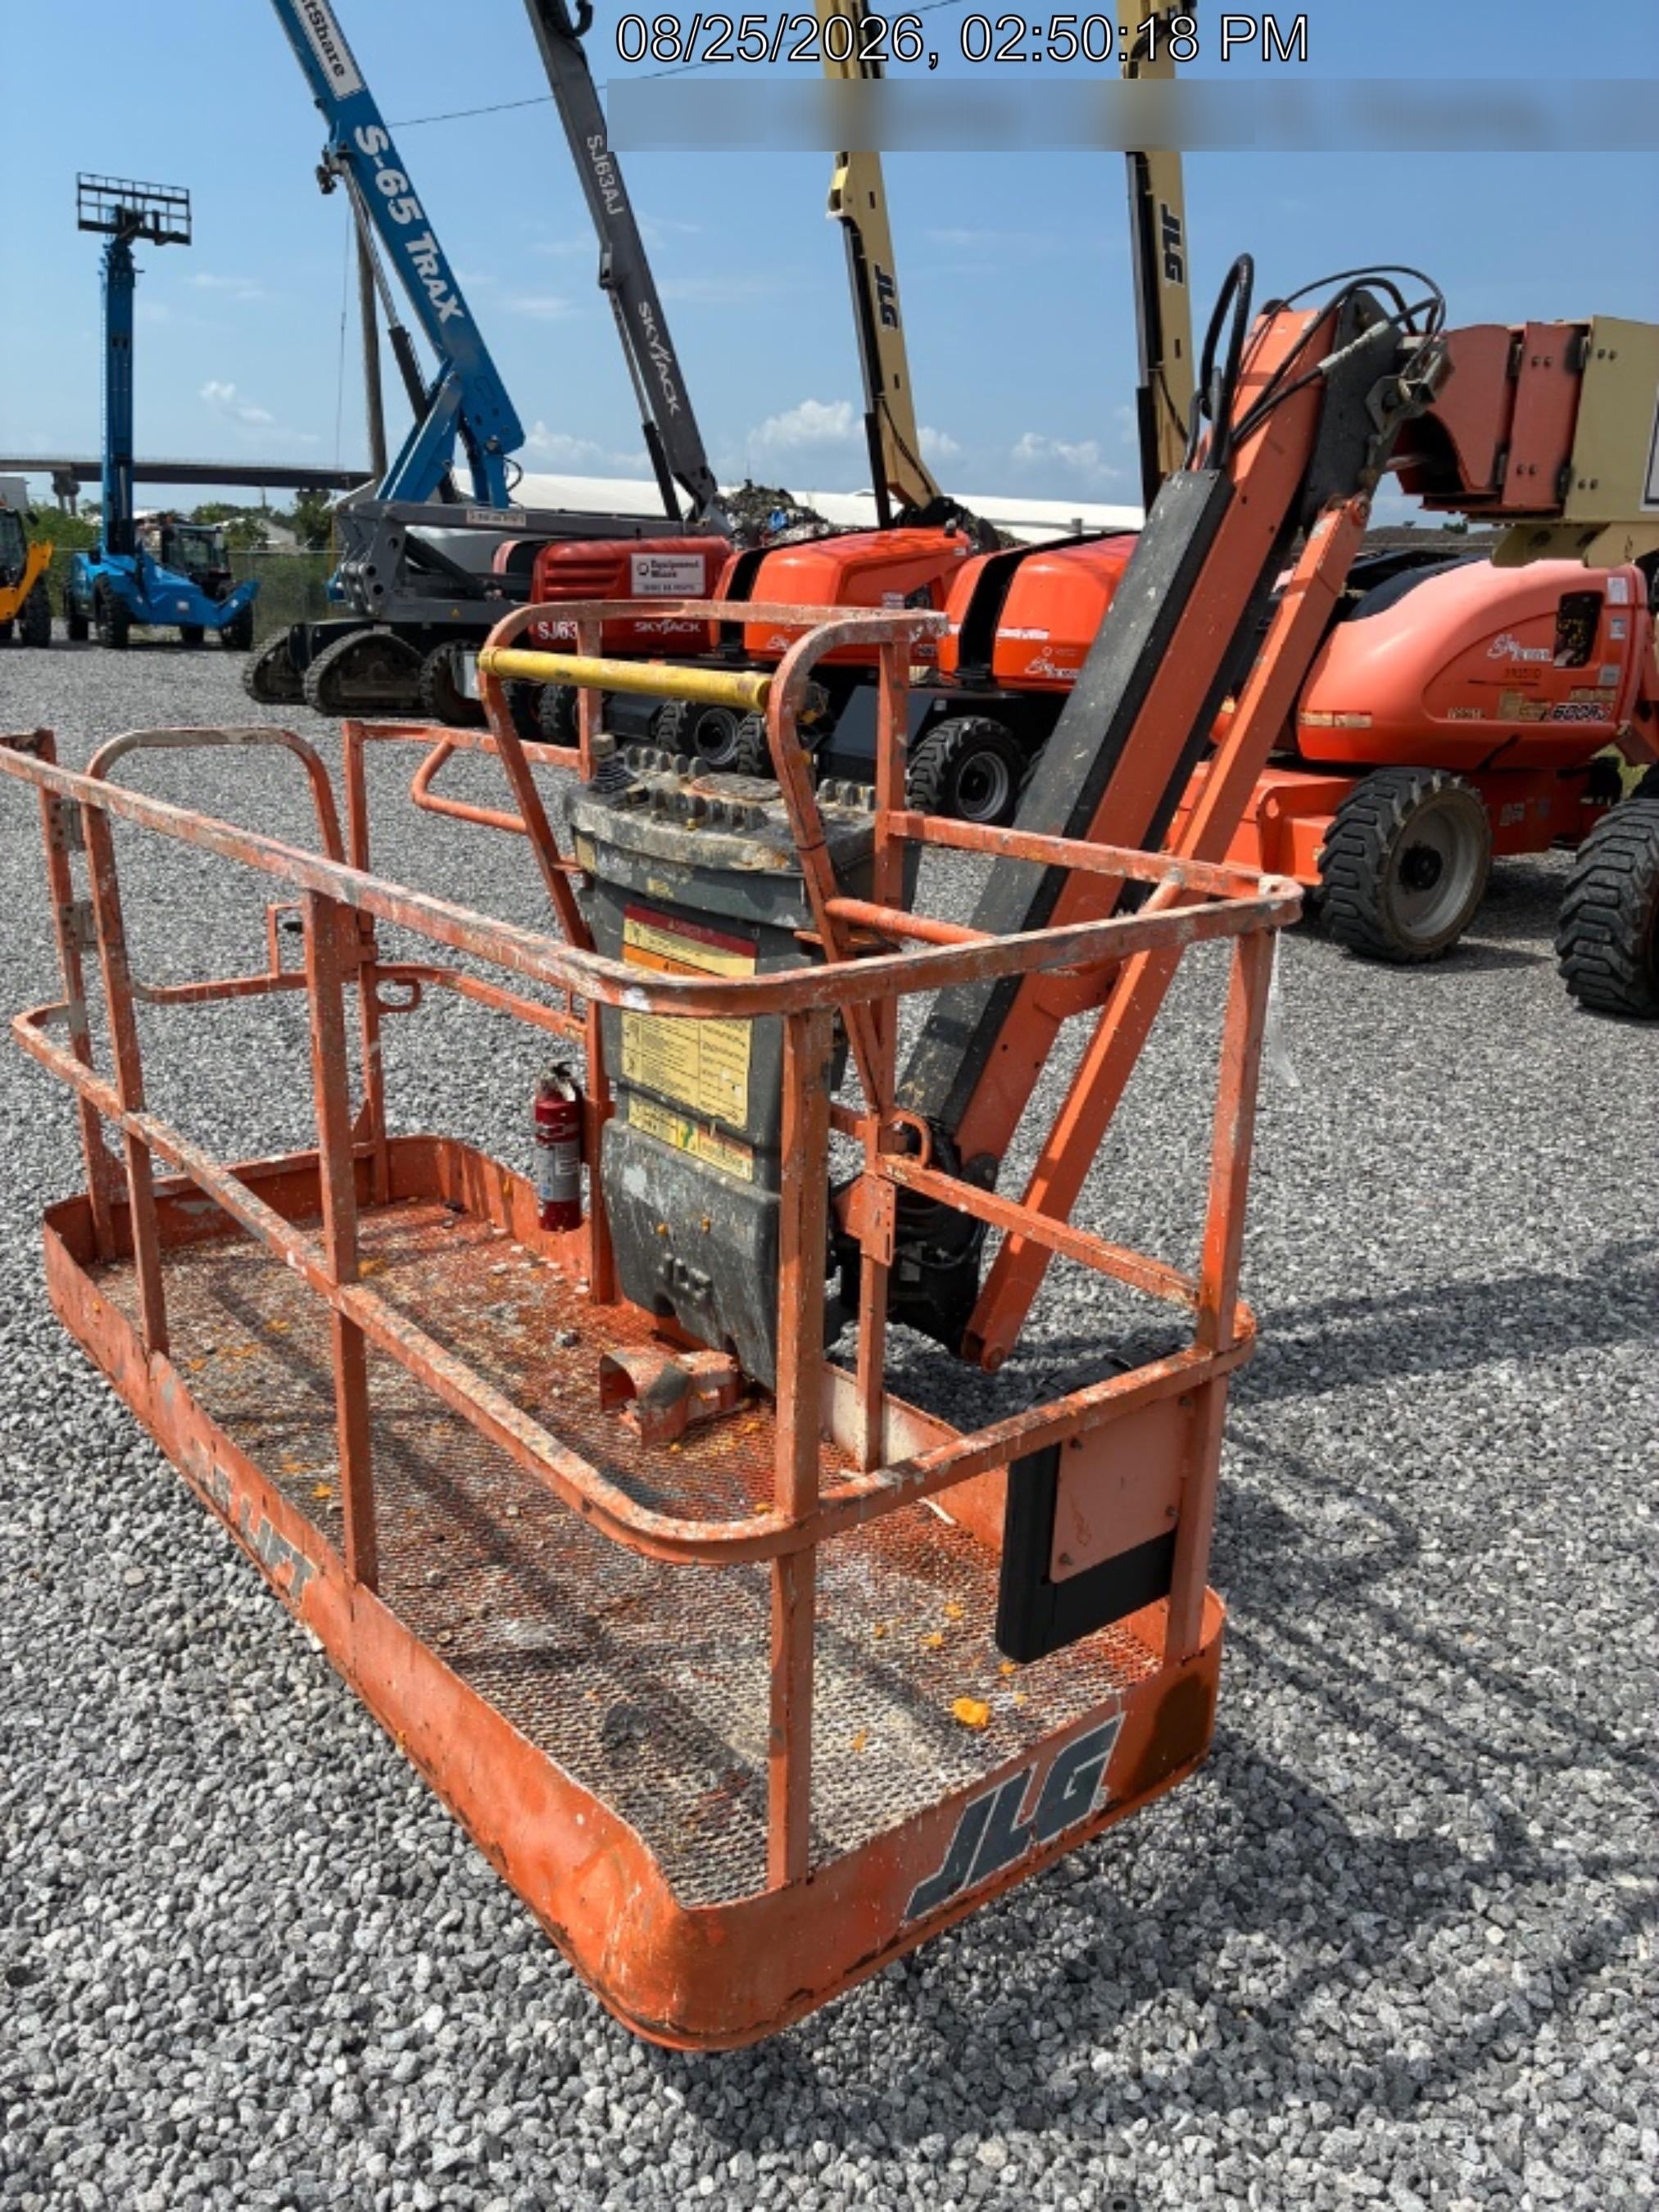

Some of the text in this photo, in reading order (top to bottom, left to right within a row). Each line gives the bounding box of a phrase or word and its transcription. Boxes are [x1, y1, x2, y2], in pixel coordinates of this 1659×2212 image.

[301, 0, 346, 77] tShare
[587, 134, 625, 216] SJ63AJ
[353, 125, 465, 324] S-65 TRAX
[1159, 202, 1185, 287] JLG
[873, 264, 899, 331] JLG
[638, 301, 681, 416] SKYJACK
[634, 618, 701, 635] SKYJACK
[904, 1711, 1126, 1927] JLG
